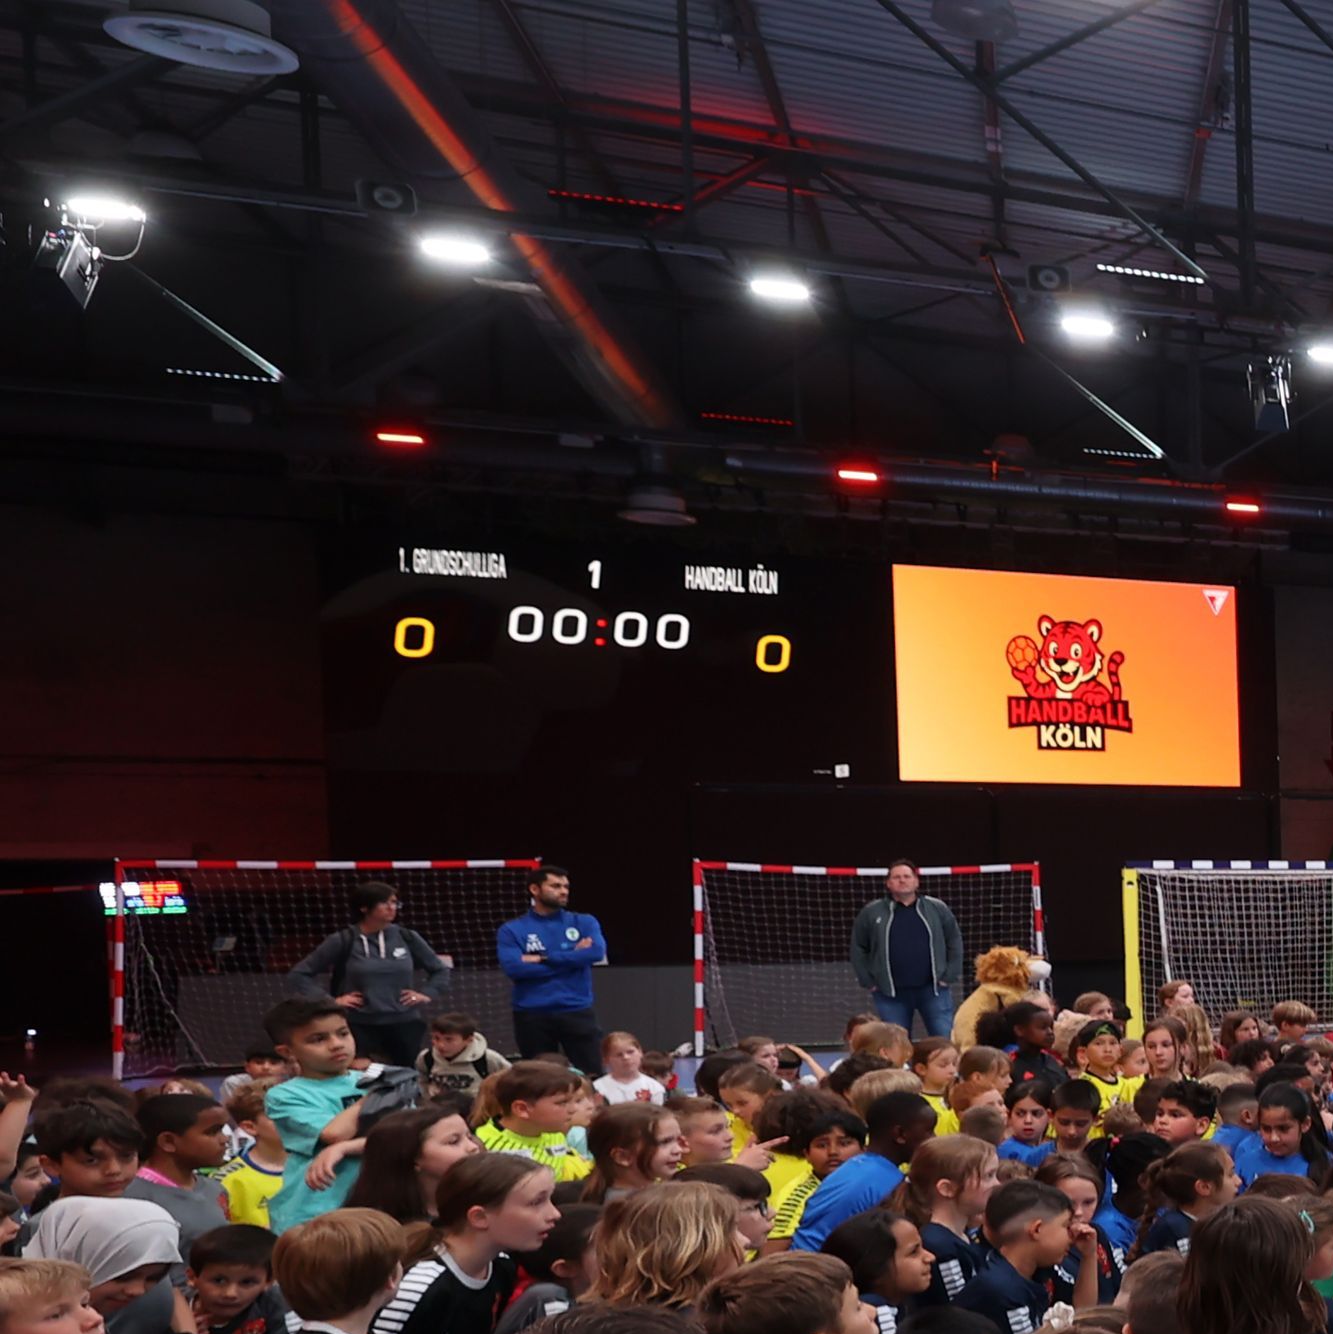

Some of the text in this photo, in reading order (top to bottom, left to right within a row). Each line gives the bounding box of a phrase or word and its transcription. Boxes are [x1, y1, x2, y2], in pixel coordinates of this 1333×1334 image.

[412, 549, 507, 578] GRUNDSCHULLIGA
[588, 560, 602, 589] 1
[685, 564, 778, 594] HANDBALL KÖLN
[394, 617, 435, 658] 0
[507, 606, 690, 649] 00:00
[756, 635, 792, 673] 0
[1011, 700, 1130, 726] HANDBALL
[1040, 723, 1102, 748] KÖLN
